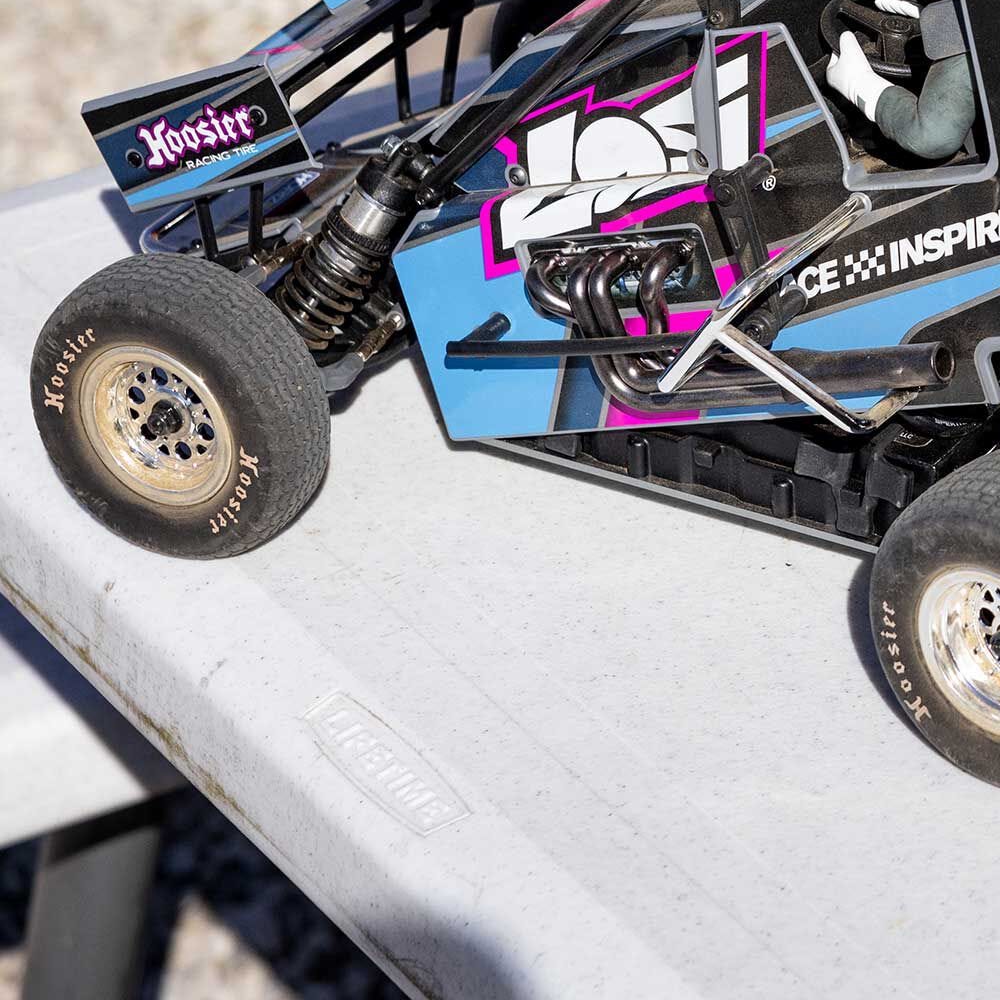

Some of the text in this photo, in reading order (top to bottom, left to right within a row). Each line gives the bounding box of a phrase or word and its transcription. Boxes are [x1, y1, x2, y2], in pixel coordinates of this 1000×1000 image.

[139, 107, 251, 166] Hoosier
[186, 143, 258, 169] RACING TIRE
[43, 328, 96, 414] Hoosier
[209, 446, 259, 534] Hoosier
[880, 600, 932, 721] Hoosier
